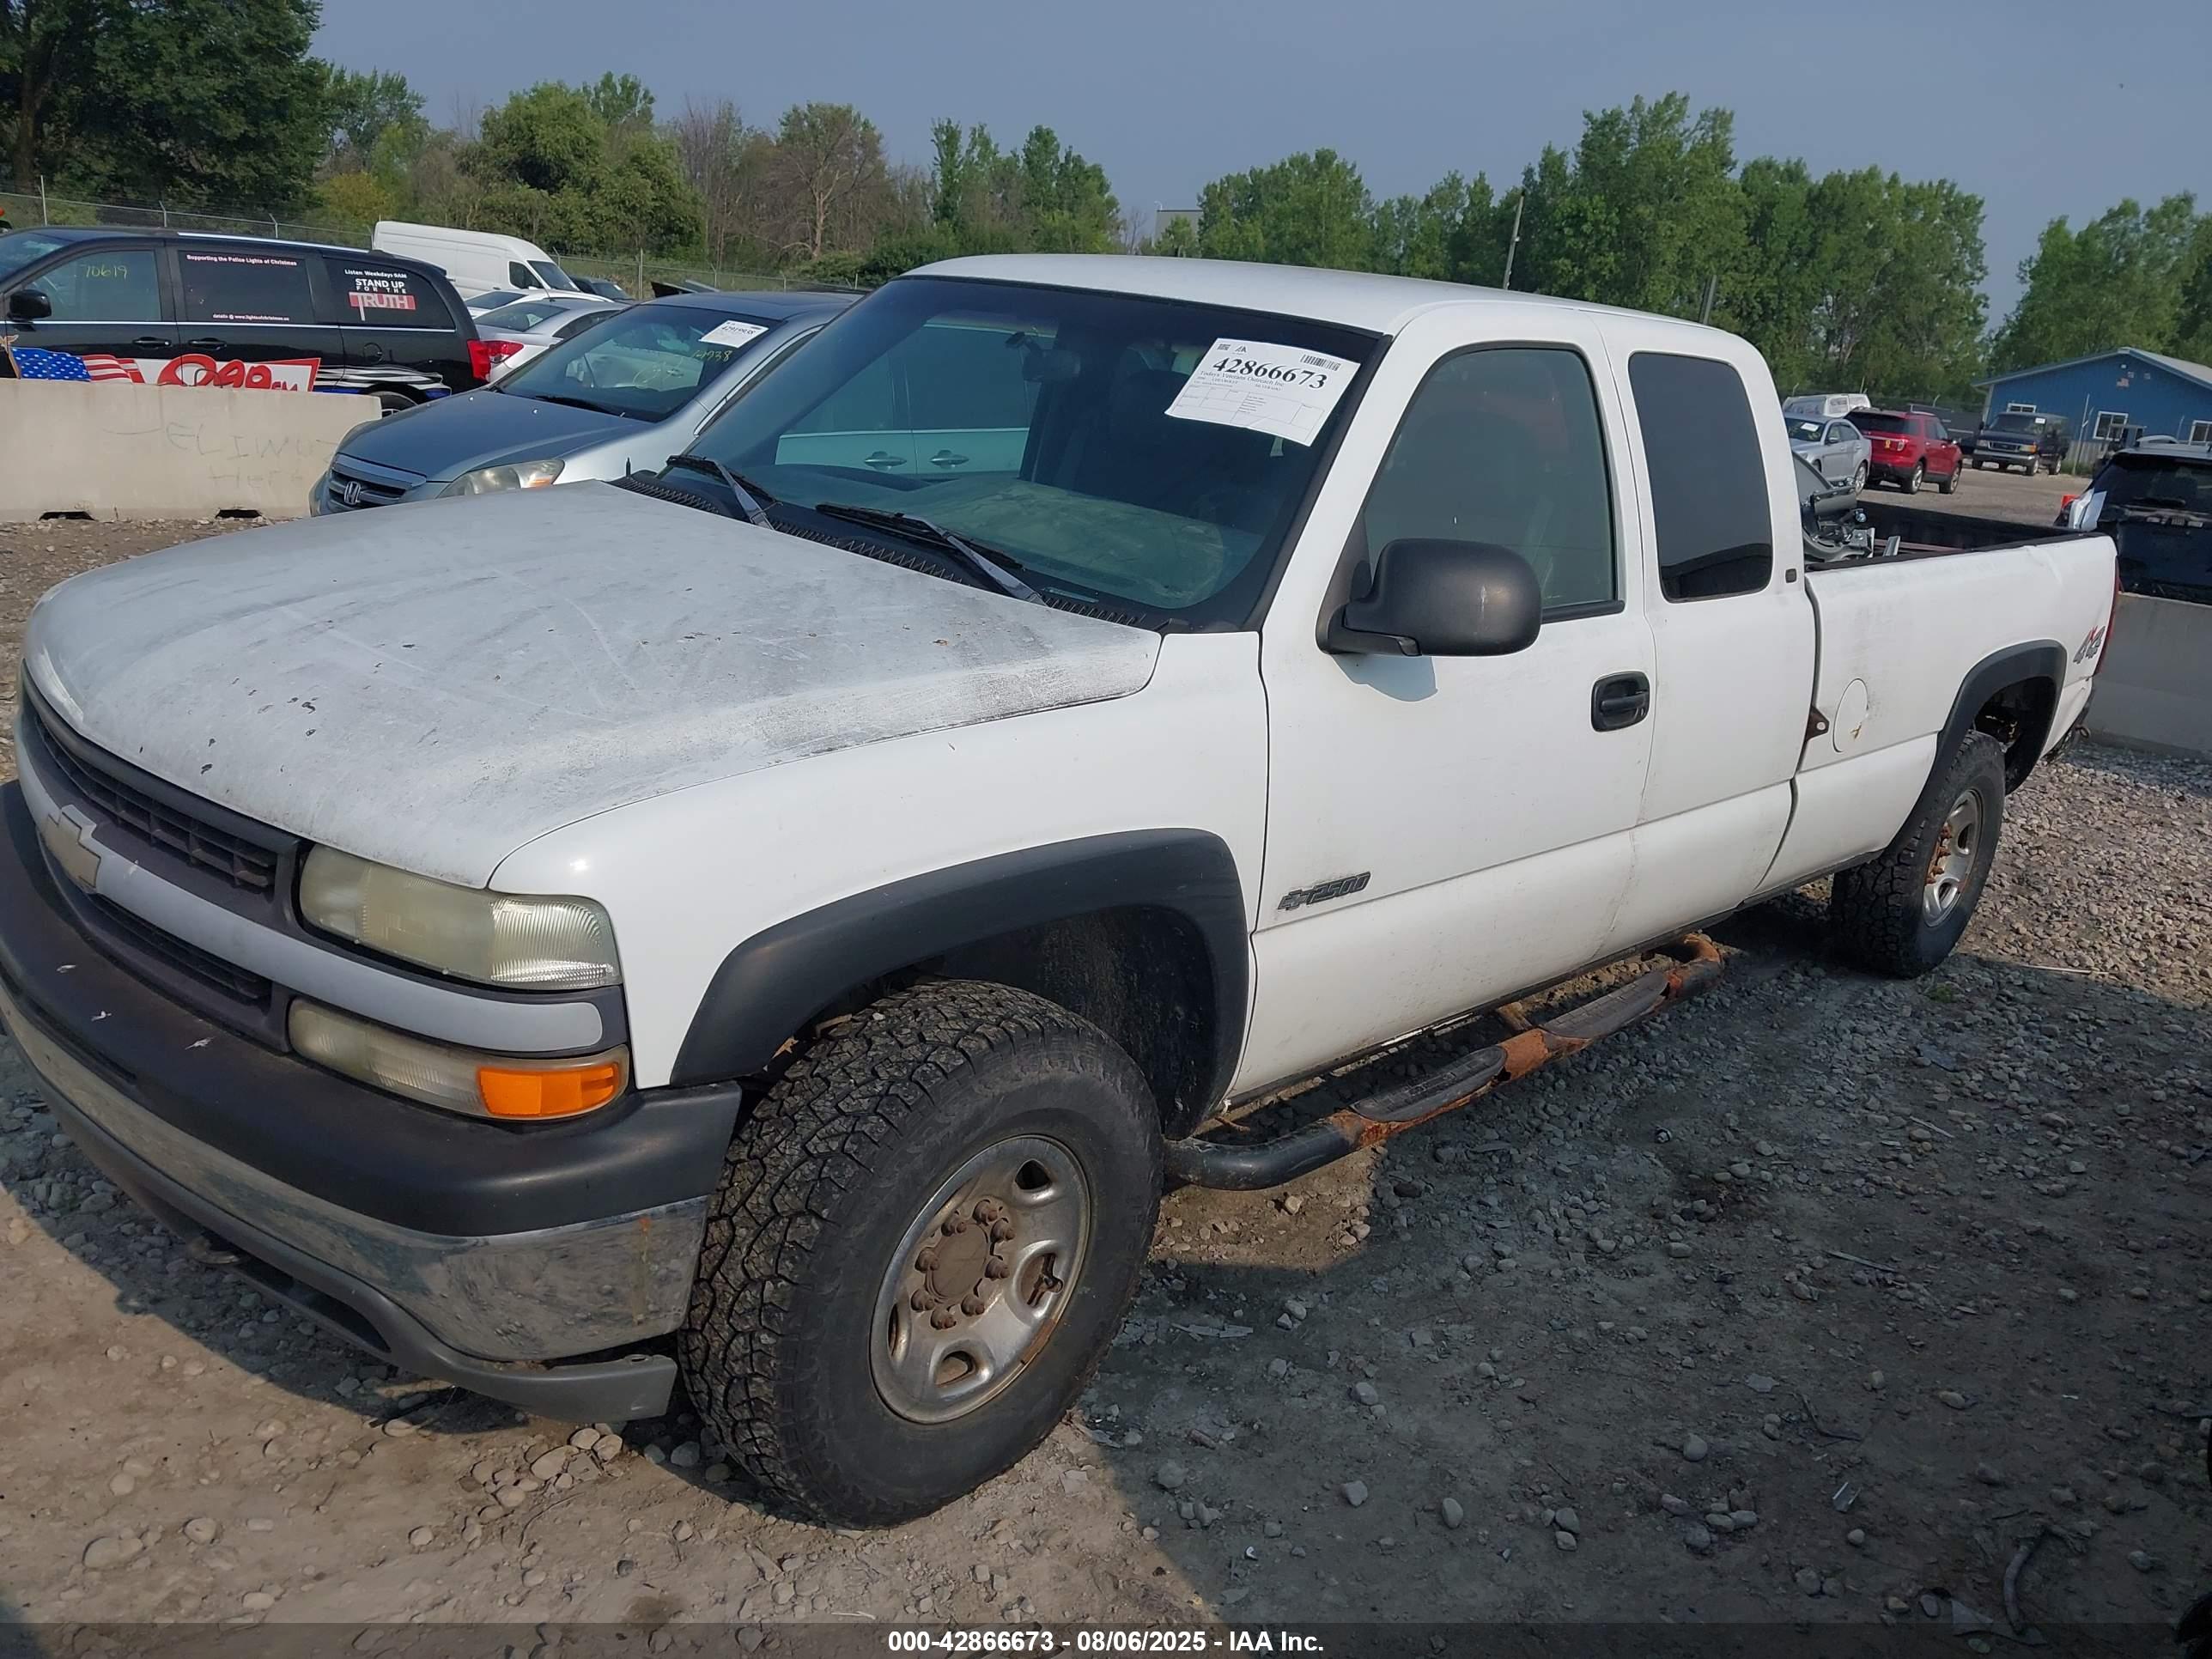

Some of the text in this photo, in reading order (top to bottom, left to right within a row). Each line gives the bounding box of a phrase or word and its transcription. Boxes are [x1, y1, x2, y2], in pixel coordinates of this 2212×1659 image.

[186, 254, 217, 263] Supporting
[356, 278, 389, 288] STAND
[349, 292, 409, 321] TRUTH
[1212, 357, 1328, 389] 42866673
